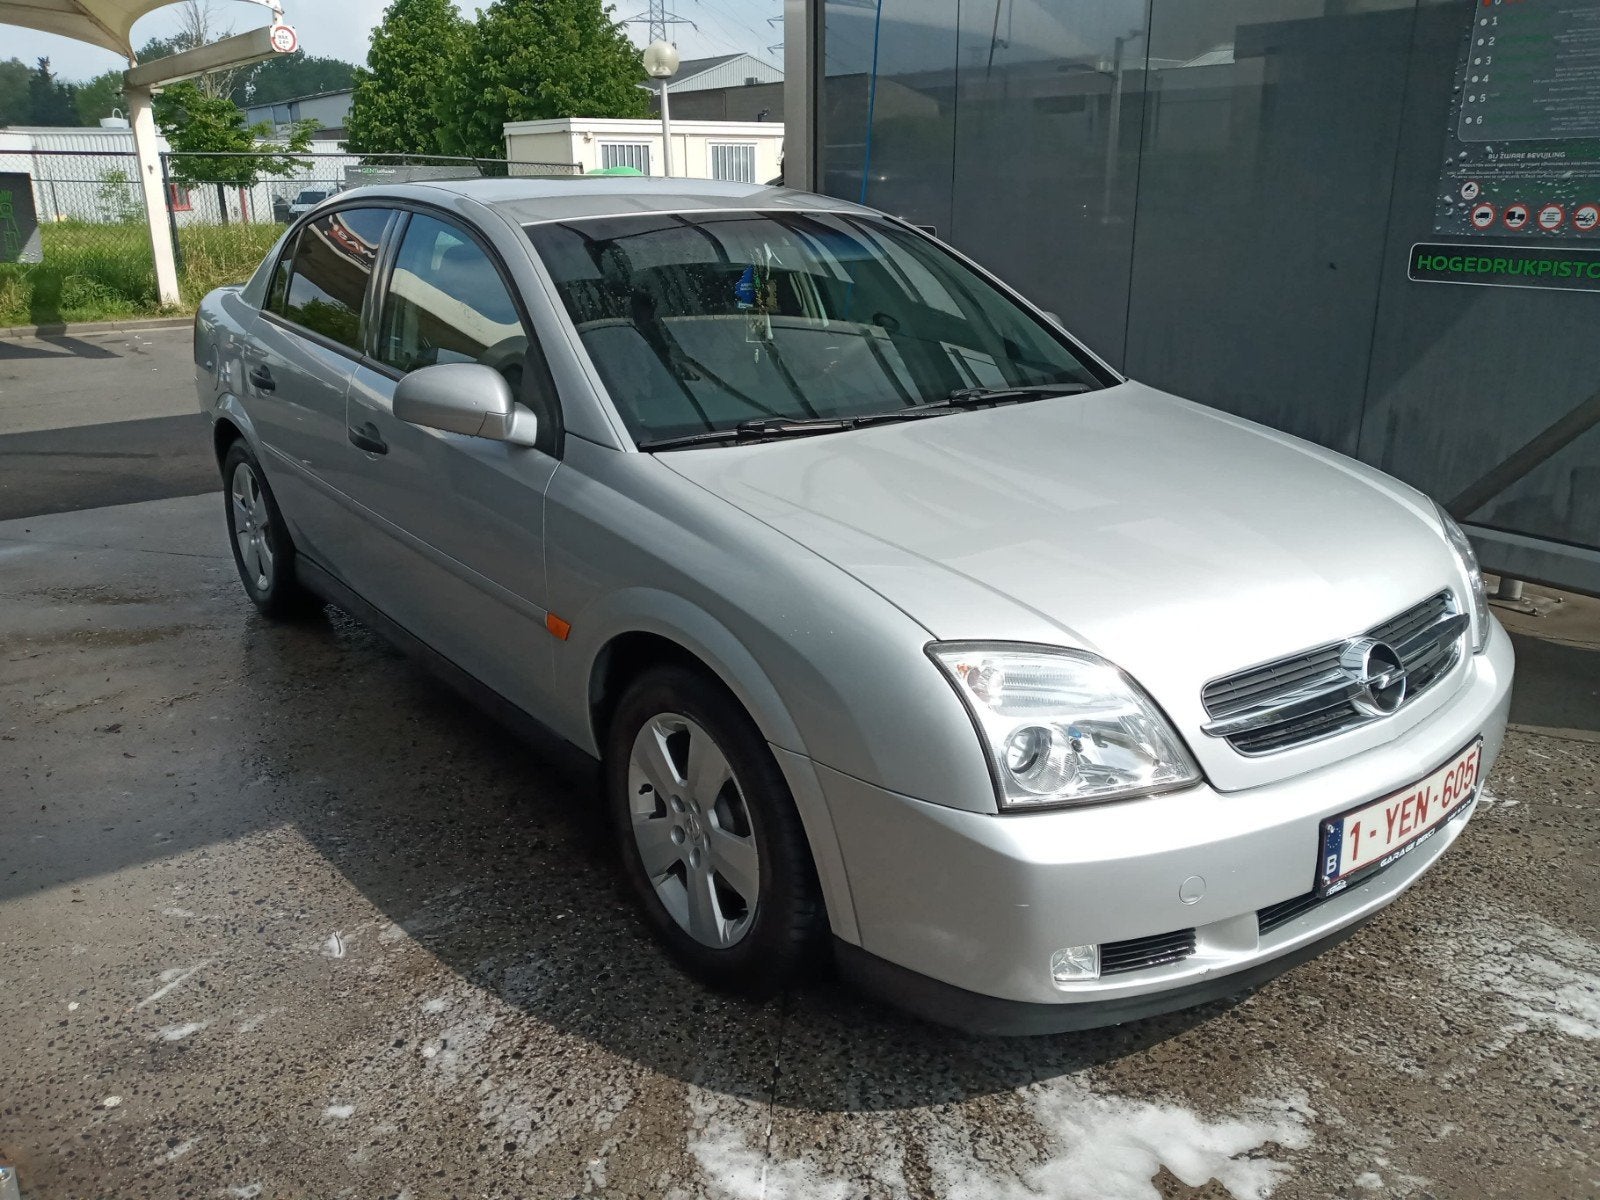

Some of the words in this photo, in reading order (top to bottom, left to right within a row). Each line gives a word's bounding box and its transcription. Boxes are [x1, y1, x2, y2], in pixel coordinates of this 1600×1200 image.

[1491, 16, 1499, 26] 1
[1488, 37, 1496, 46] 2
[1485, 56, 1492, 66] 3
[1482, 74, 1490, 84] 4
[1479, 93, 1487, 103] 5
[1476, 115, 1483, 125] 6
[1326, 854, 1338, 874] B
